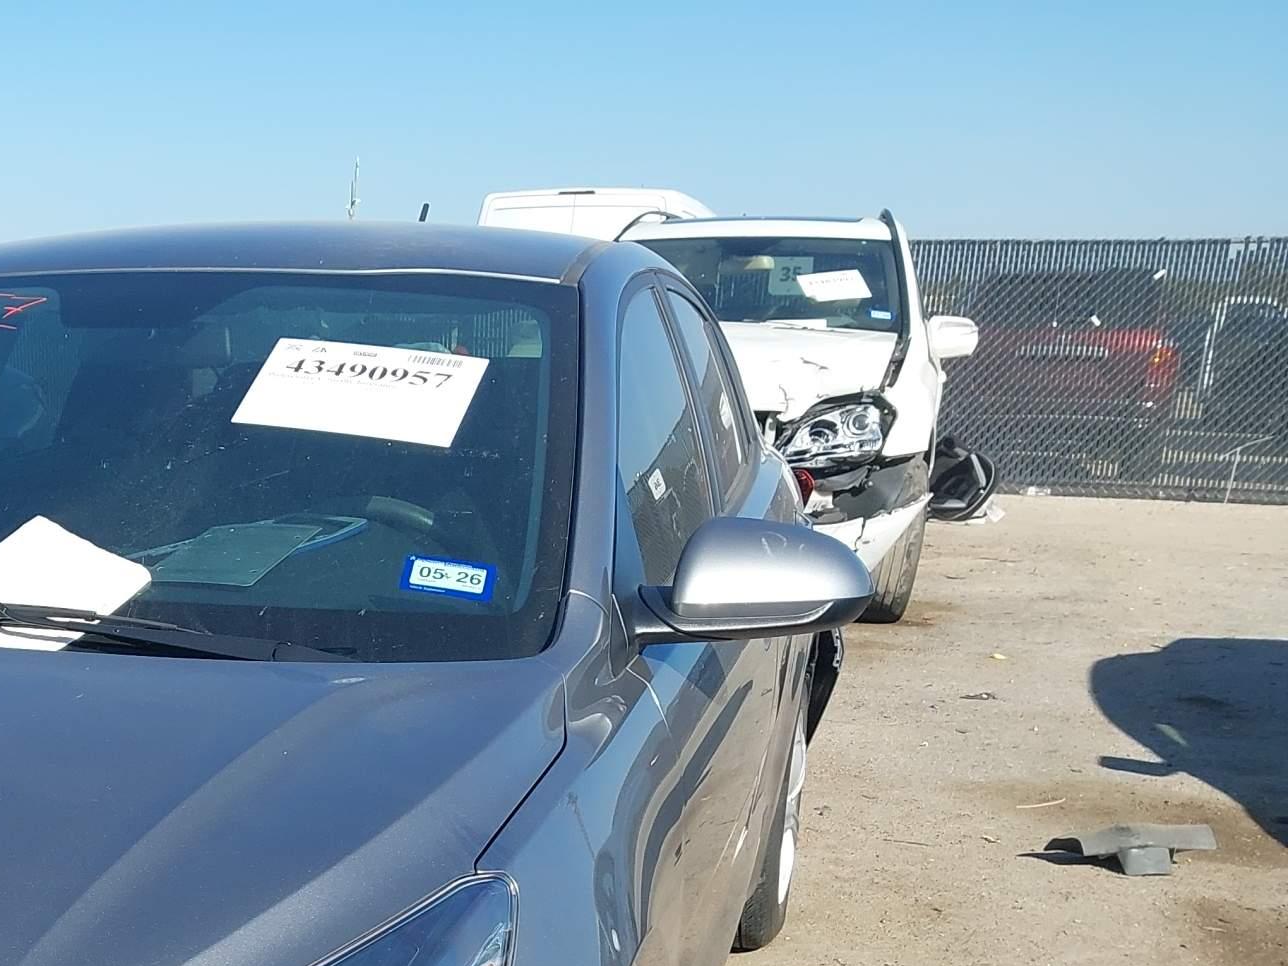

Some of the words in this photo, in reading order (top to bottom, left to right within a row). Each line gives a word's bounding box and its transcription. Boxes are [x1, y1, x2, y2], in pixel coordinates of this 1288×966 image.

[286, 358, 453, 388] 43490957
[419, 566, 445, 580] 05
[456, 571, 483, 586] 26
